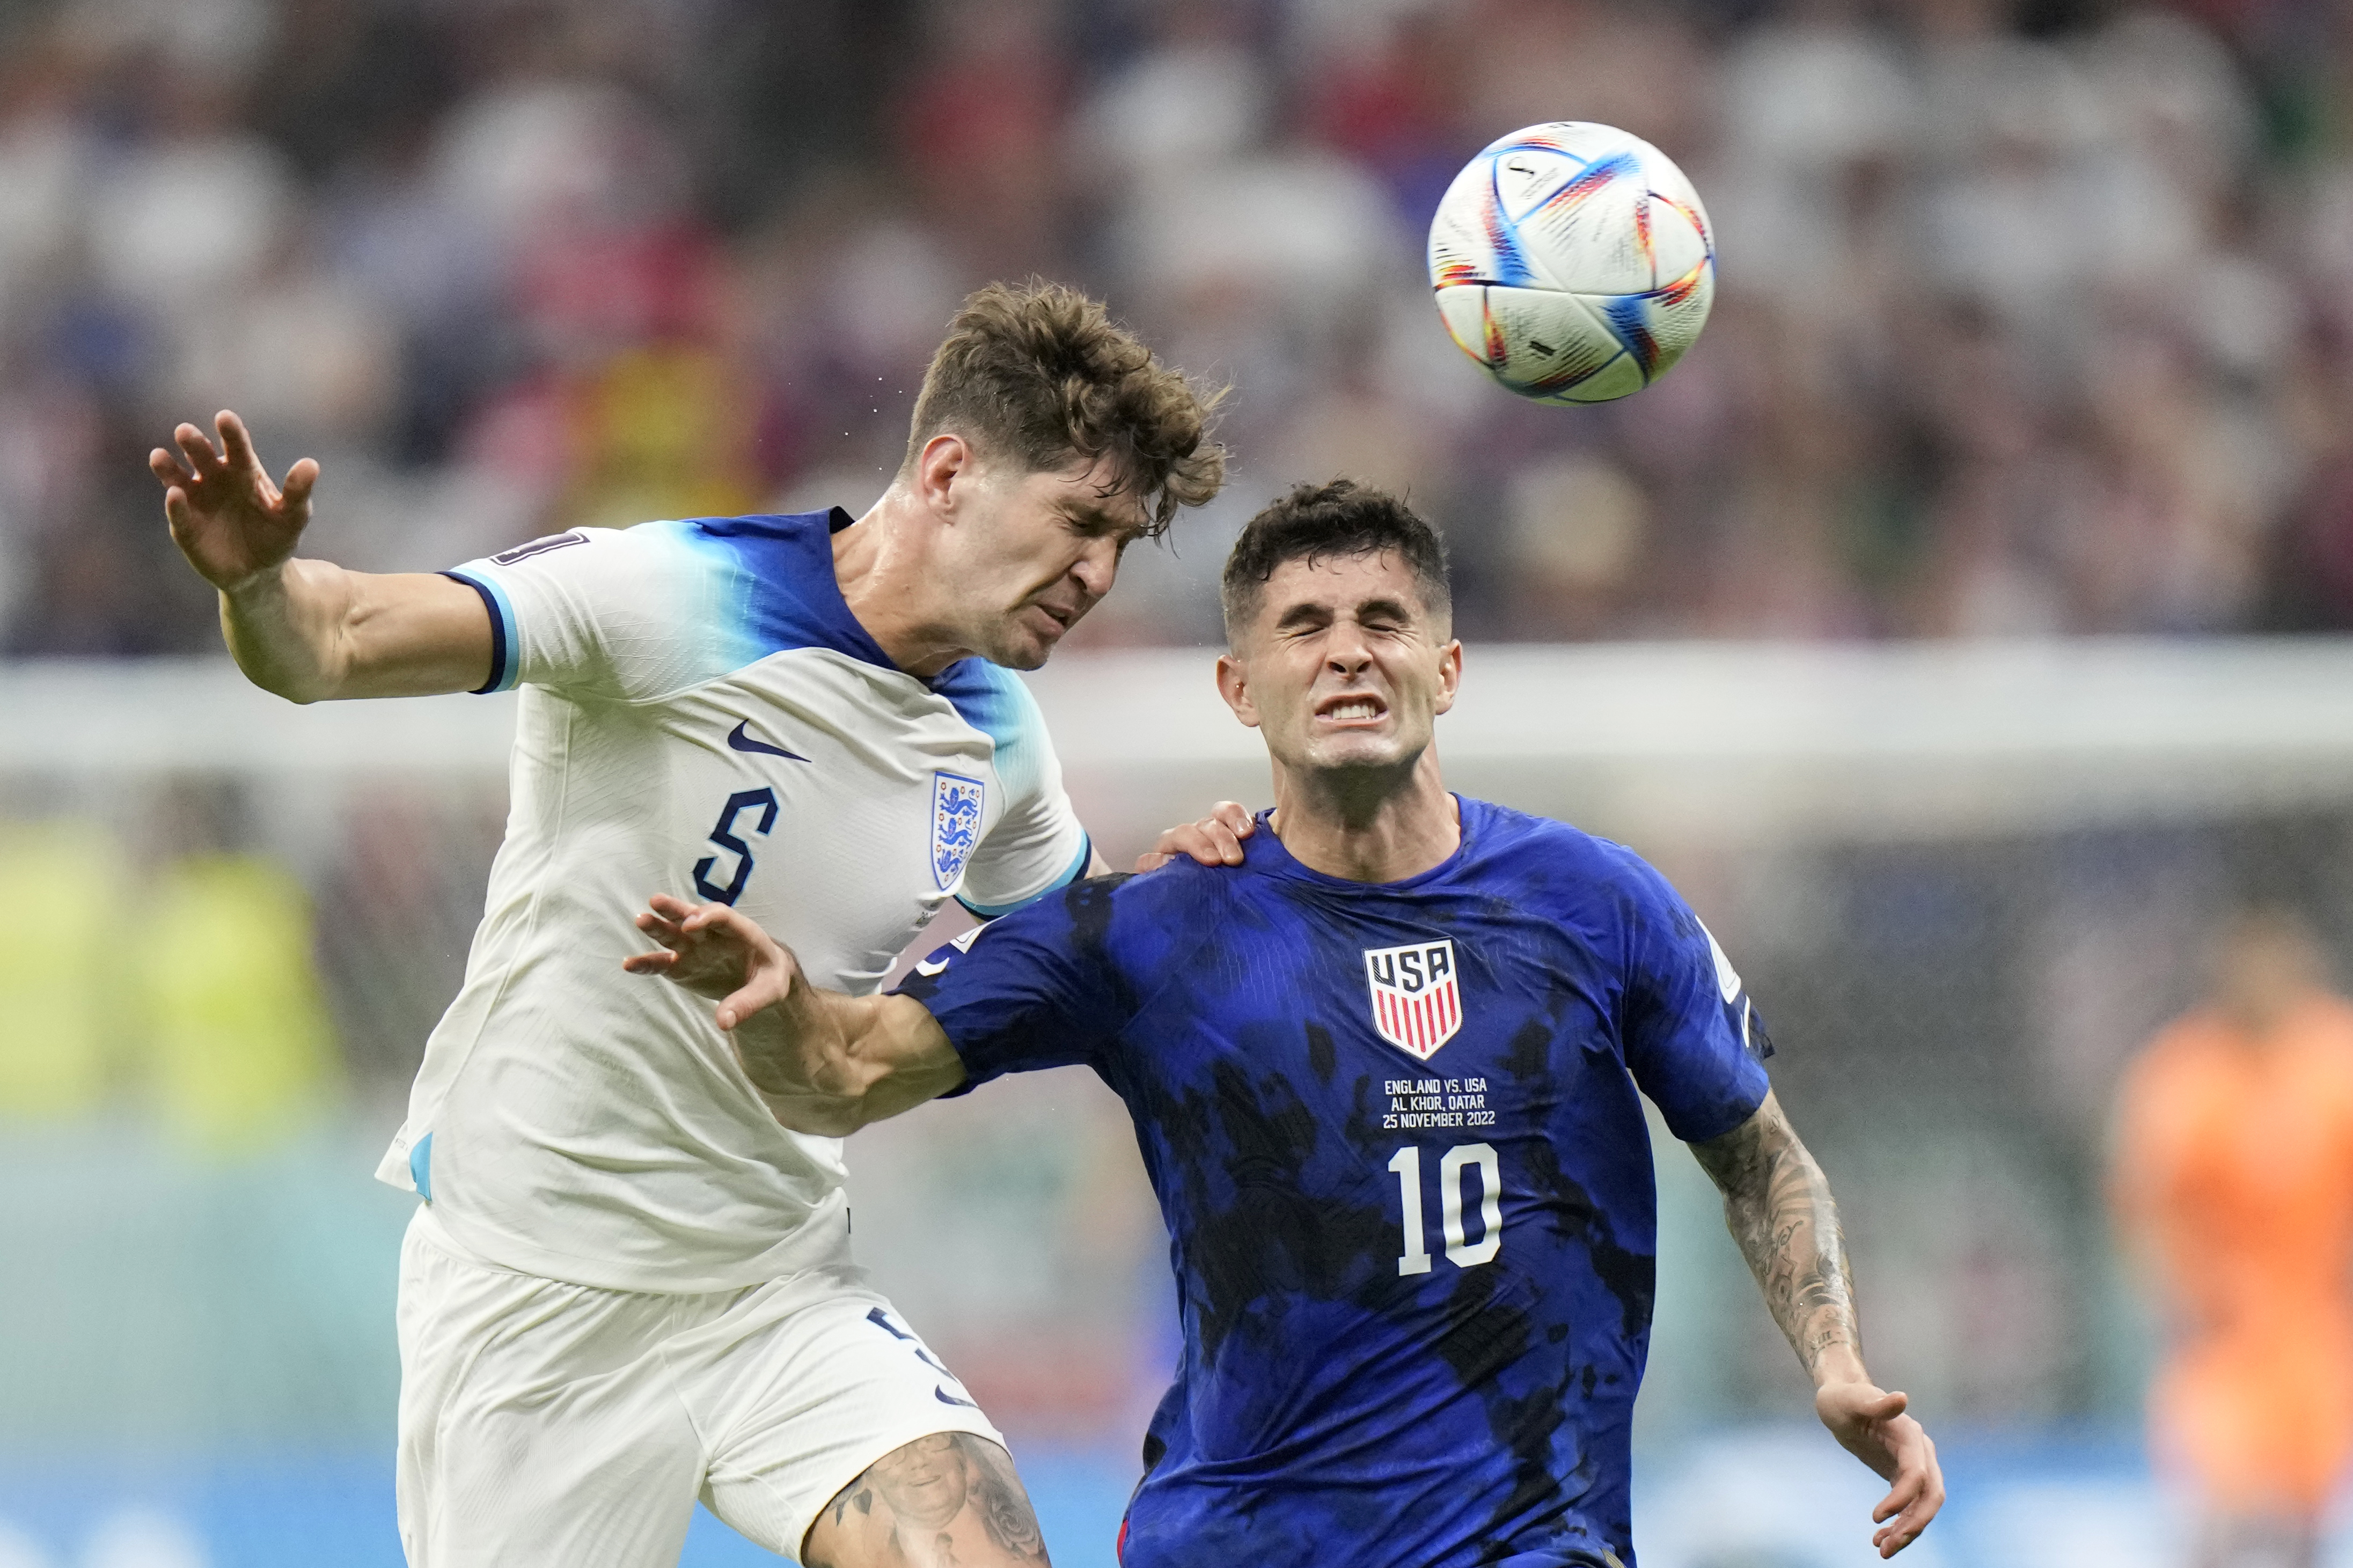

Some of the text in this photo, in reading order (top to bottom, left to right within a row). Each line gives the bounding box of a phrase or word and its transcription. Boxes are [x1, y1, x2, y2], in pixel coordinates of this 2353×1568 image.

[693, 787, 779, 907] 5
[1371, 947, 1449, 993] USA
[1384, 1078, 1487, 1095] ENGLAND VS. USA
[1391, 1094, 1485, 1111] AL KHOR, QATAR
[1382, 1111, 1495, 1129] 25 NOVEMBER 2022
[1388, 1143, 1502, 1276] 10
